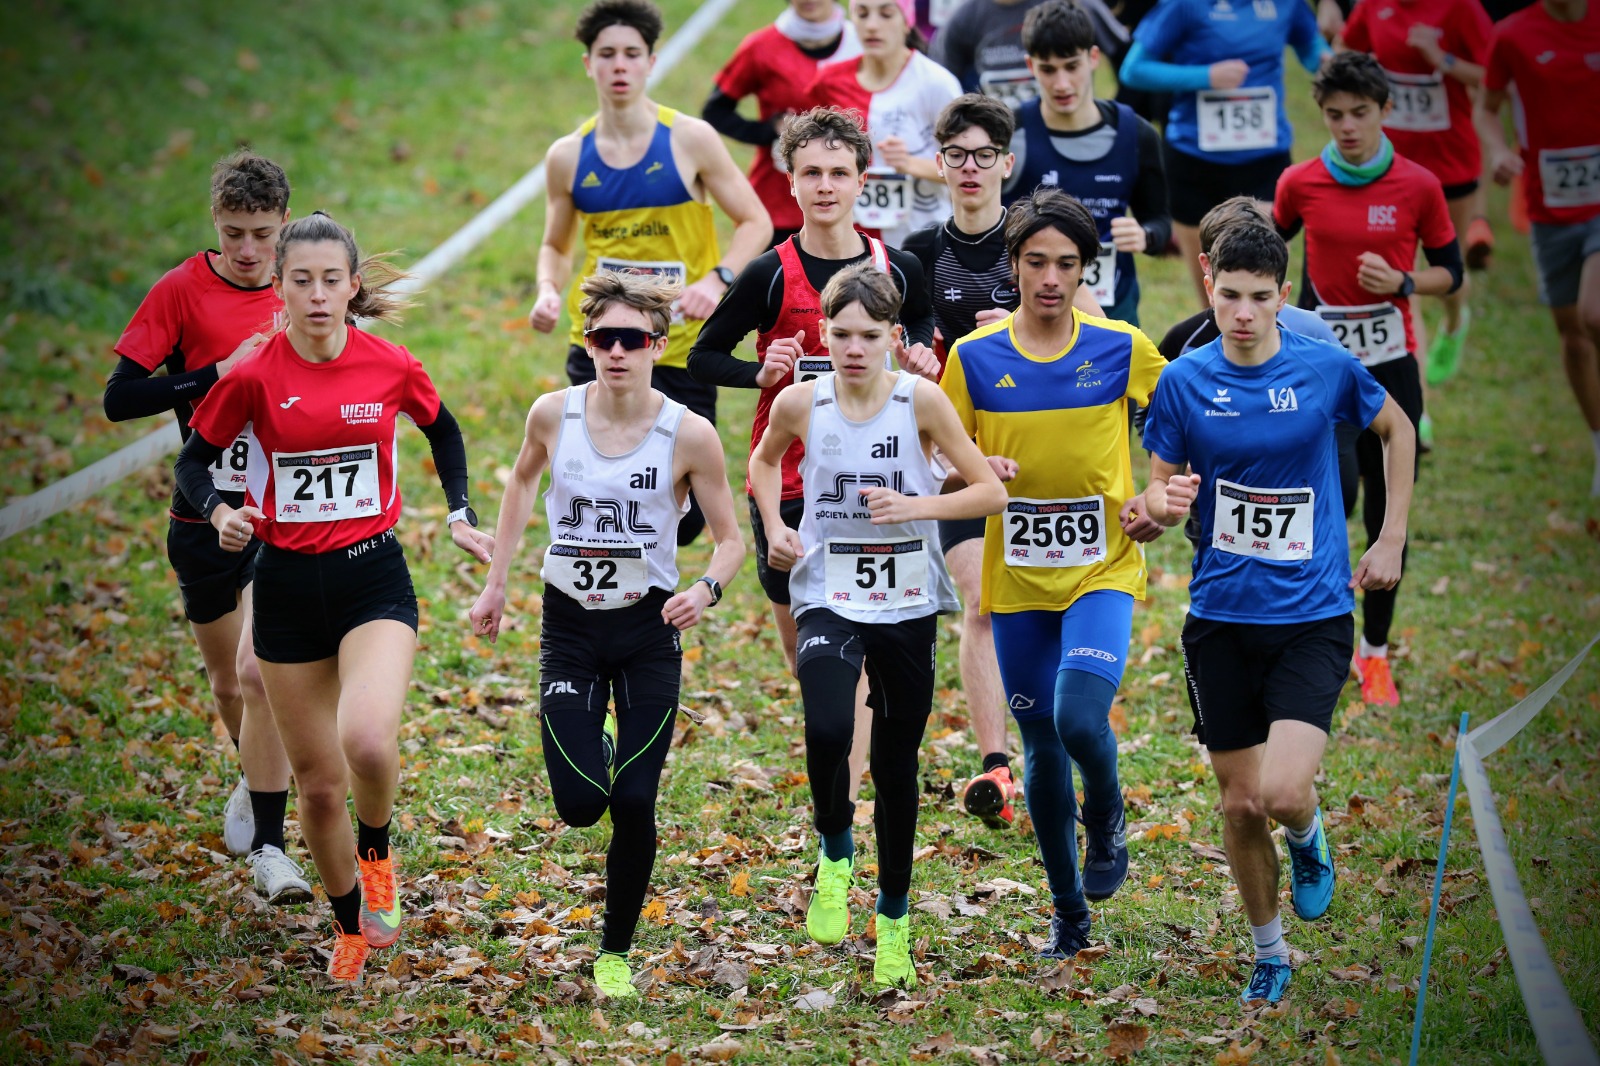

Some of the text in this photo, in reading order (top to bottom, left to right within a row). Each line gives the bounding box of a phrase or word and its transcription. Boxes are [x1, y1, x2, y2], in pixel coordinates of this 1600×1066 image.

[1214, 104, 1263, 130] 158
[858, 184, 905, 208] 581
[1367, 204, 1397, 225] USC
[631, 221, 670, 236] Gialle
[1085, 260, 1101, 285] 3
[1333, 319, 1388, 349] 215
[1075, 379, 1102, 389] FGM
[340, 402, 383, 419] VIGOR
[346, 417, 378, 425] Ligornetto
[870, 435, 899, 459] ail
[230, 474, 247, 483] FTA
[293, 463, 360, 501] 217
[629, 466, 658, 490] ail
[1009, 513, 1099, 548] 2569
[1231, 503, 1296, 539] 157
[347, 538, 379, 559] NIKE
[572, 560, 618, 591] 32
[855, 556, 896, 589] 51
[1066, 647, 1118, 663] ACERBIS
